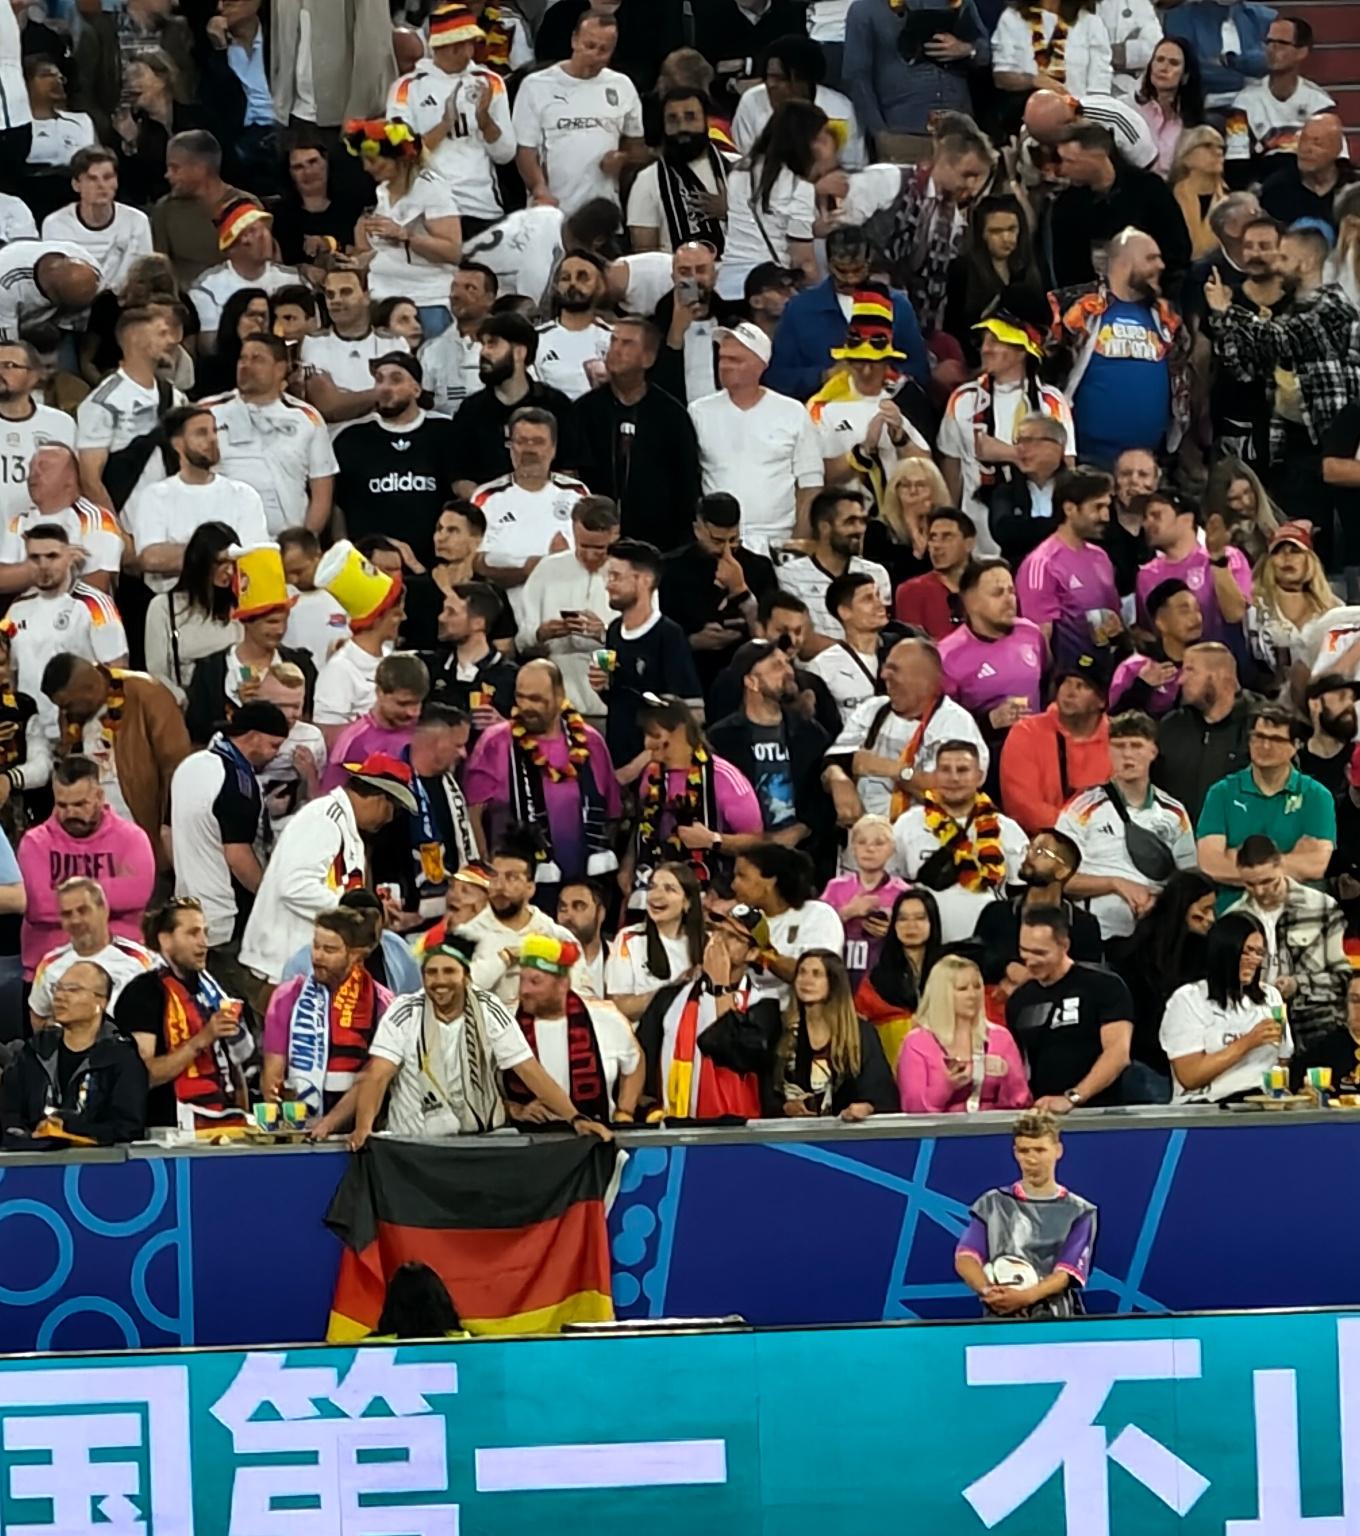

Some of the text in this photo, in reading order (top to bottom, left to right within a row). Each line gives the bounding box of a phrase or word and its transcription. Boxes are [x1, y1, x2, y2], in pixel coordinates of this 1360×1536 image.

[0, 453, 26, 484] 13
[369, 471, 437, 493] adidas
[846, 940, 869, 970] 10
